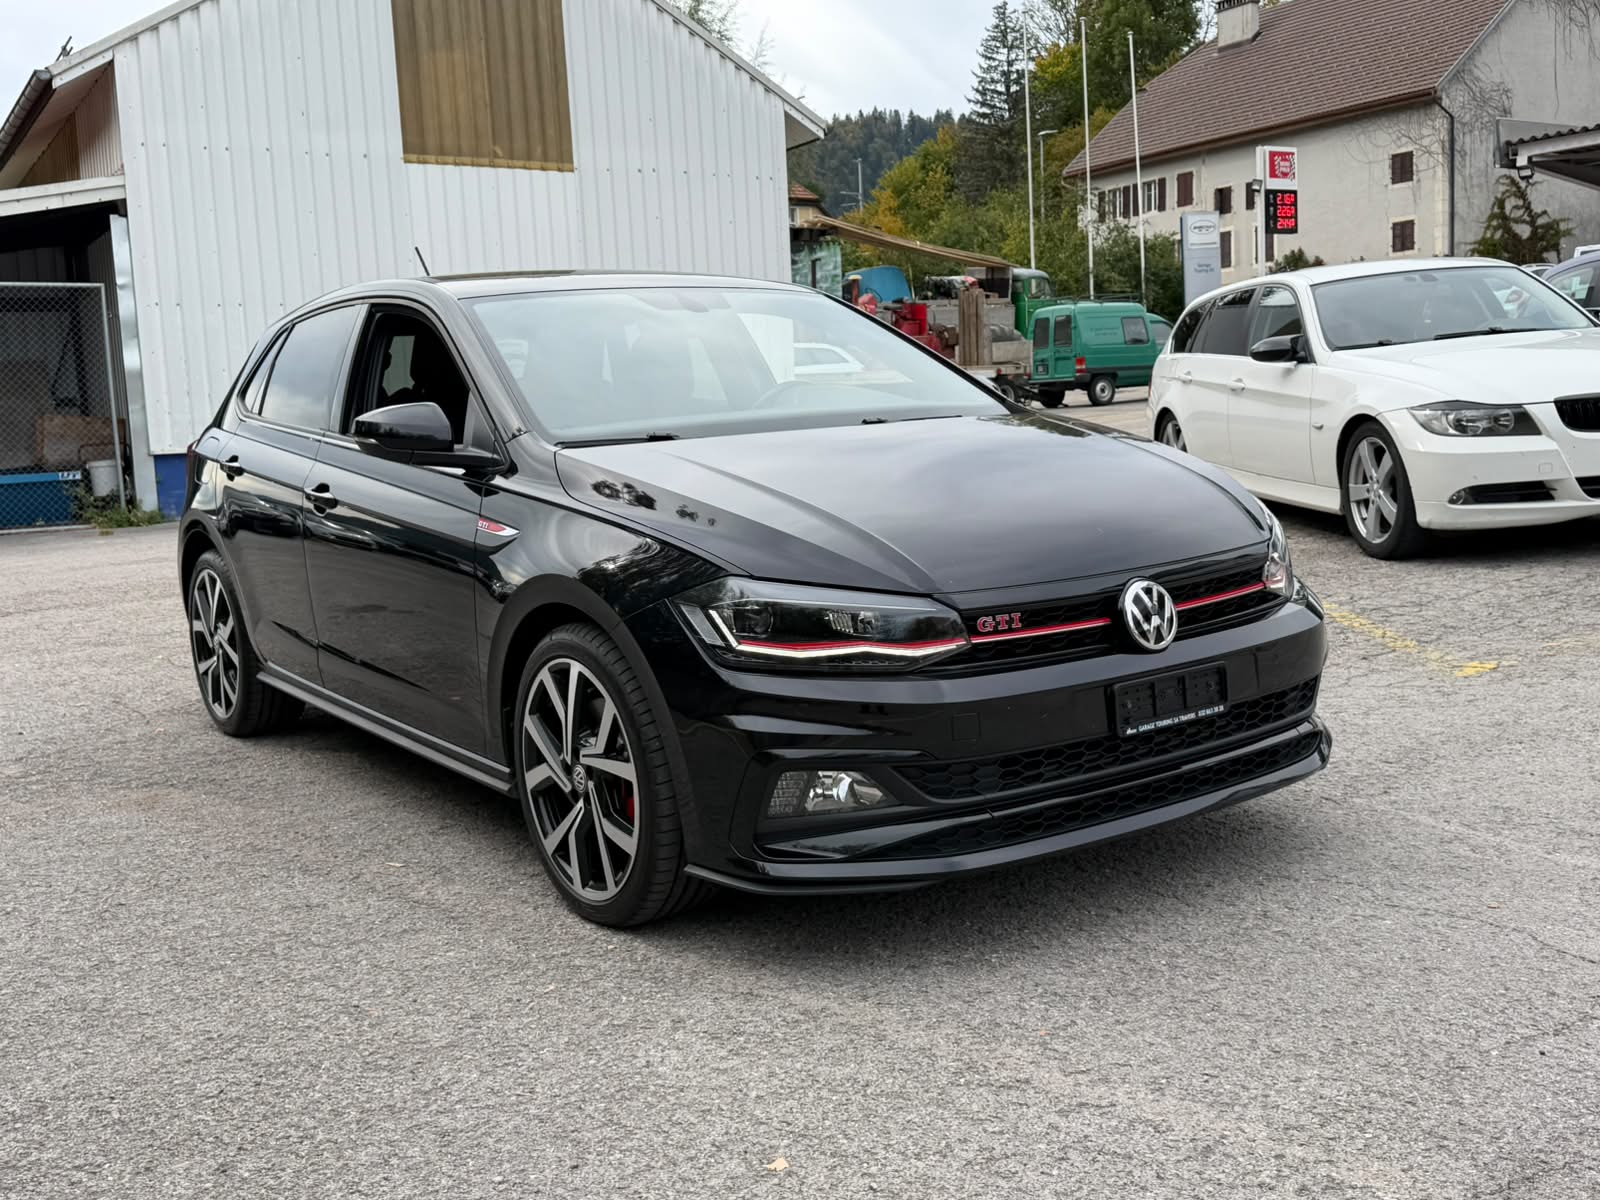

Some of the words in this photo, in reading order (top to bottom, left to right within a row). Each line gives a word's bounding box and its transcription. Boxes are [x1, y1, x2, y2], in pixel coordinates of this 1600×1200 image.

[478, 520, 489, 529] GTI
[977, 613, 1022, 632] GTI
[1138, 722, 1155, 731] GARAGE
[1155, 718, 1173, 727] TOURING
